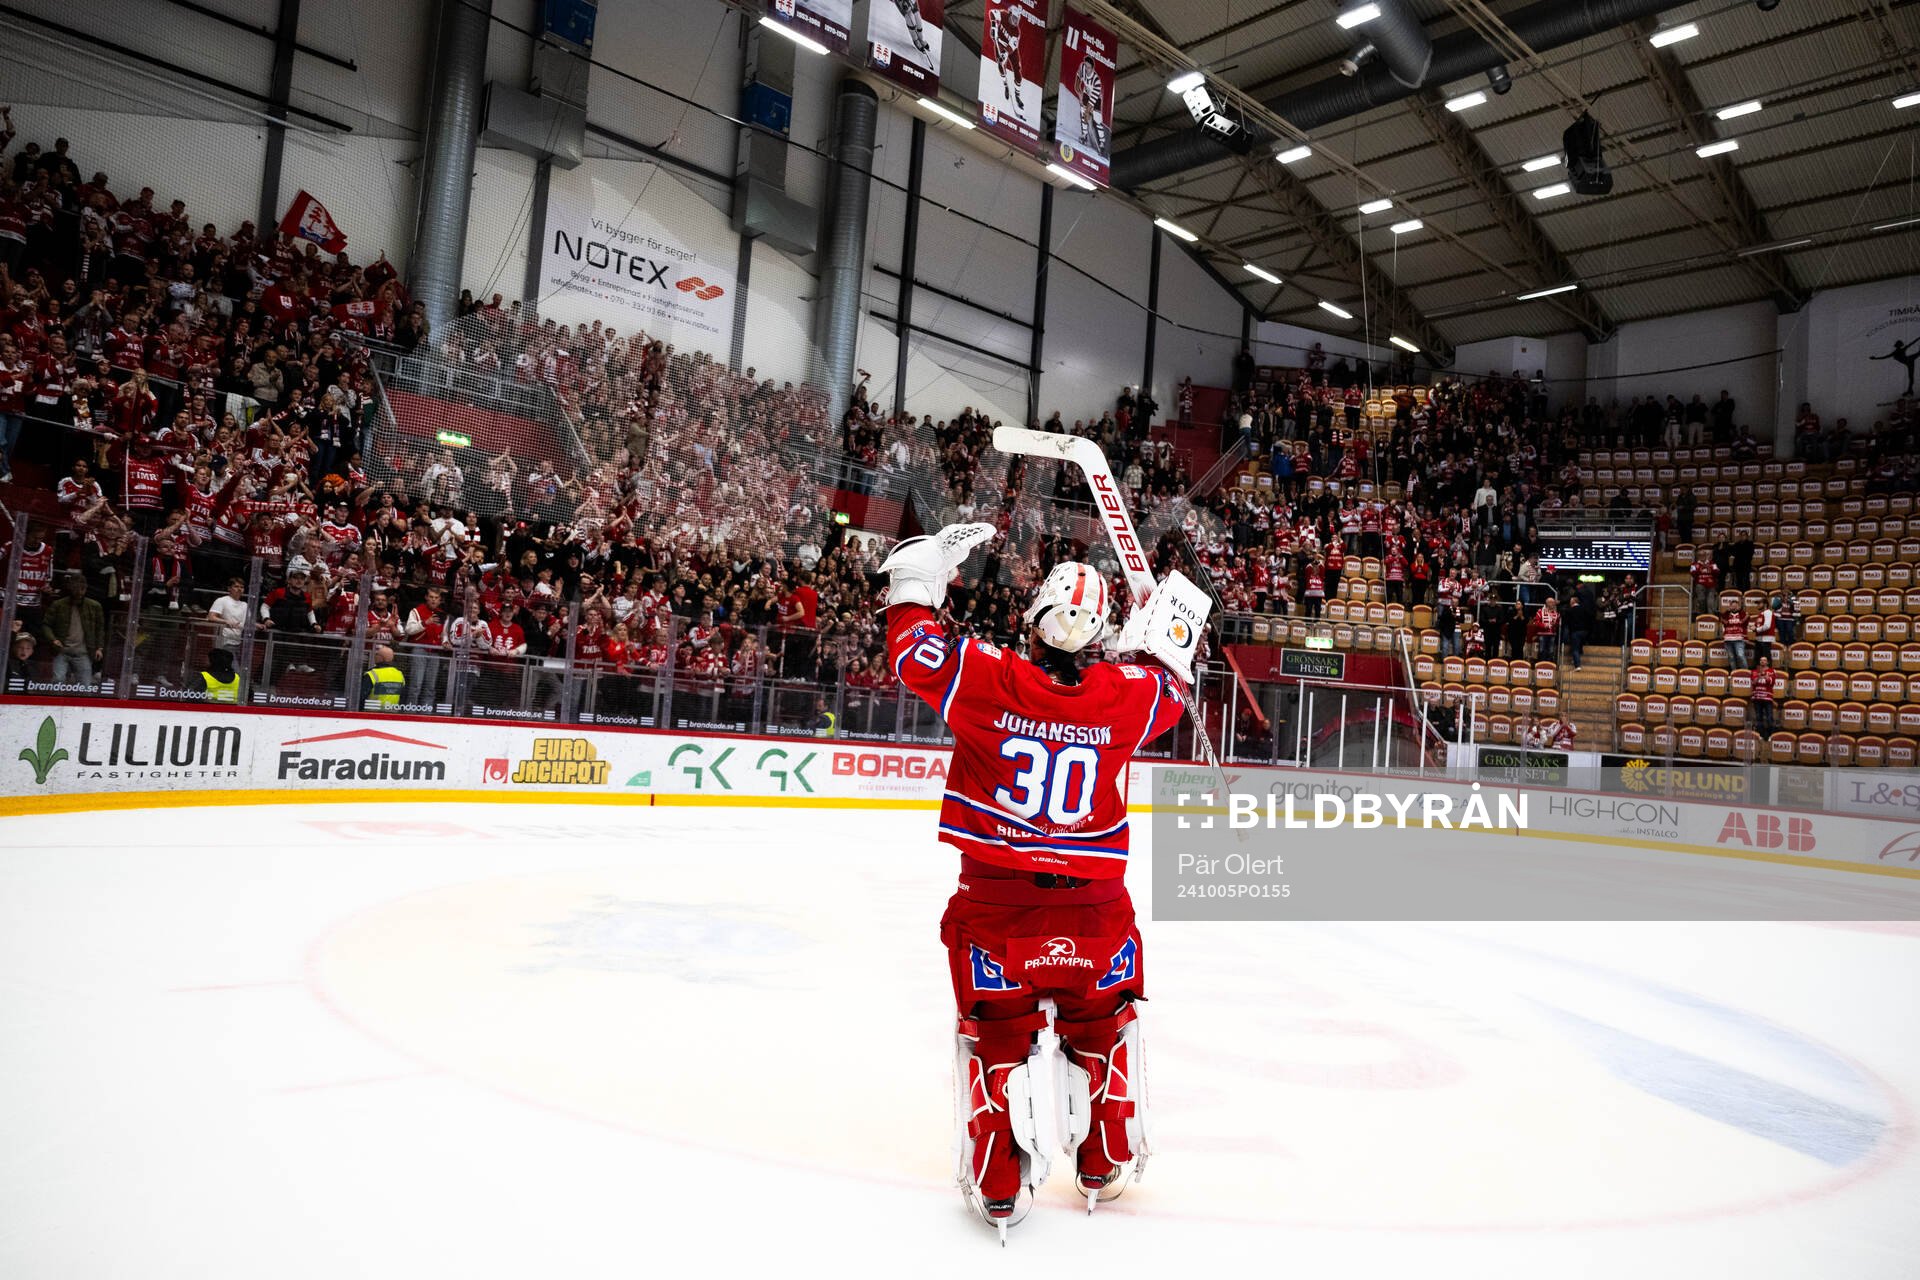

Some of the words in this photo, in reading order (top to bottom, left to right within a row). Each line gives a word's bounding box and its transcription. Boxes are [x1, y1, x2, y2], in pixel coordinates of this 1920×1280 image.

[591, 218, 603, 230] Vi
[606, 226, 644, 244] bygger
[647, 237, 662, 250] för
[665, 246, 697, 264] seger!
[554, 230, 670, 289] NOTEX
[1092, 473, 1145, 572] BAUER
[1171, 595, 1203, 627] COOR
[1286, 654, 1339, 666] GRÖNSAKS
[1300, 663, 1331, 674] HUSET
[27, 681, 99, 693] brandcode.se
[269, 694, 332, 706] brandcode.se
[486, 708, 543, 719] brandcode.se
[689, 720, 735, 731] brandcode.se
[994, 711, 1112, 745] JOHANSSON
[78, 722, 242, 767] LILIUM
[532, 738, 597, 762] EURO
[277, 751, 446, 780] Faradium
[512, 760, 611, 785] JACKPOT
[832, 752, 948, 780] BORGA
[1484, 754, 1560, 769] GRÖNSAKS
[77, 770, 238, 779] FASTIGHETER
[994, 735, 1100, 825] 30
[1163, 769, 1217, 788] Byberg
[1504, 767, 1549, 781] HUSET
[1270, 779, 1363, 805] granitor
[1549, 796, 1679, 827] HIGHCON
[1636, 827, 1679, 839] INSTALCO
[1716, 812, 1817, 852] ABB
[1024, 955, 1094, 970] PROLYMPIA
